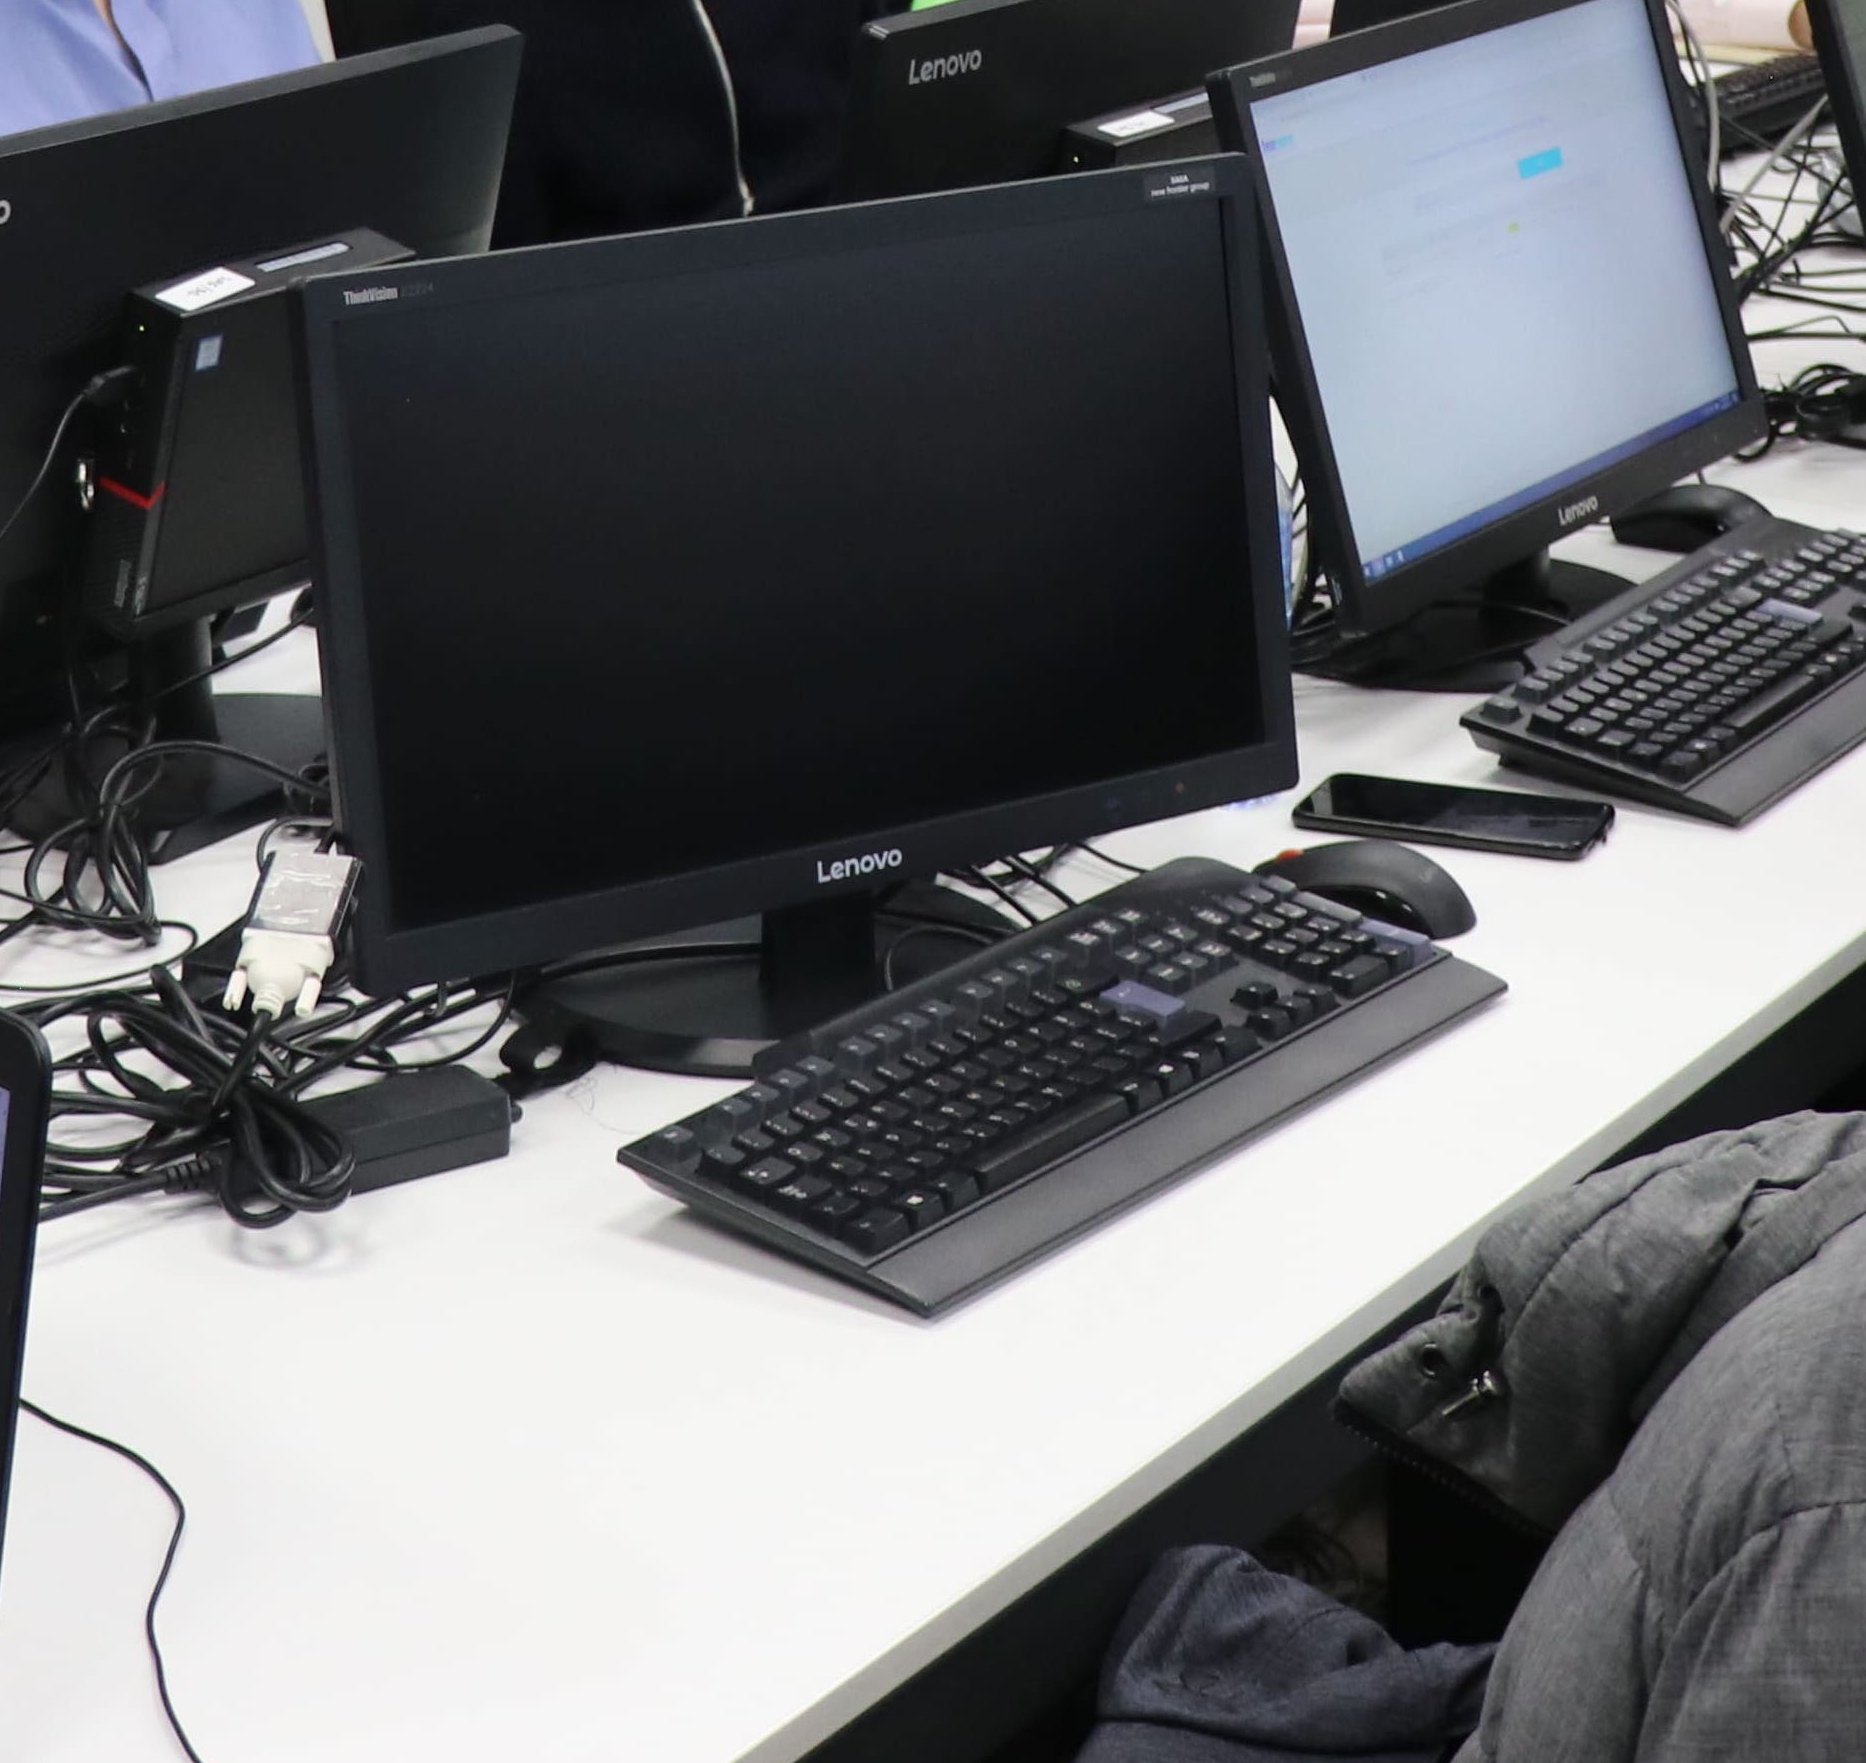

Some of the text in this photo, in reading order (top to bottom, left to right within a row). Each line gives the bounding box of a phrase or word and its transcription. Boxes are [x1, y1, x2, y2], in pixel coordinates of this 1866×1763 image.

[909, 49, 982, 85] Lenovo
[1558, 495, 1599, 527] Lenovo
[817, 848, 903, 884] Lenovo
